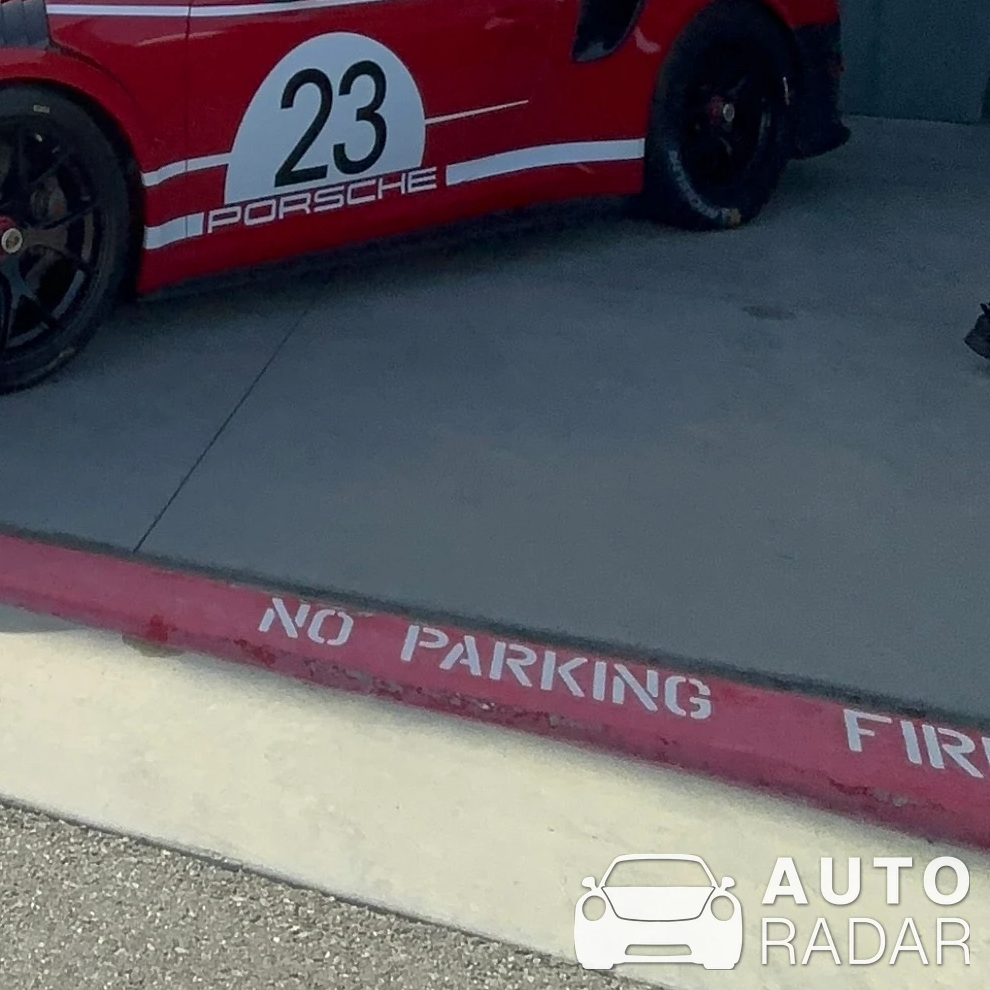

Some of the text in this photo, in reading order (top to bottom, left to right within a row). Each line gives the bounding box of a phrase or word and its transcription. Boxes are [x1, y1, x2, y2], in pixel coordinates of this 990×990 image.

[274, 60, 387, 188] 23
[208, 166, 438, 233] PORSCHE
[258, 597, 990, 778] NO PARKING FIR
